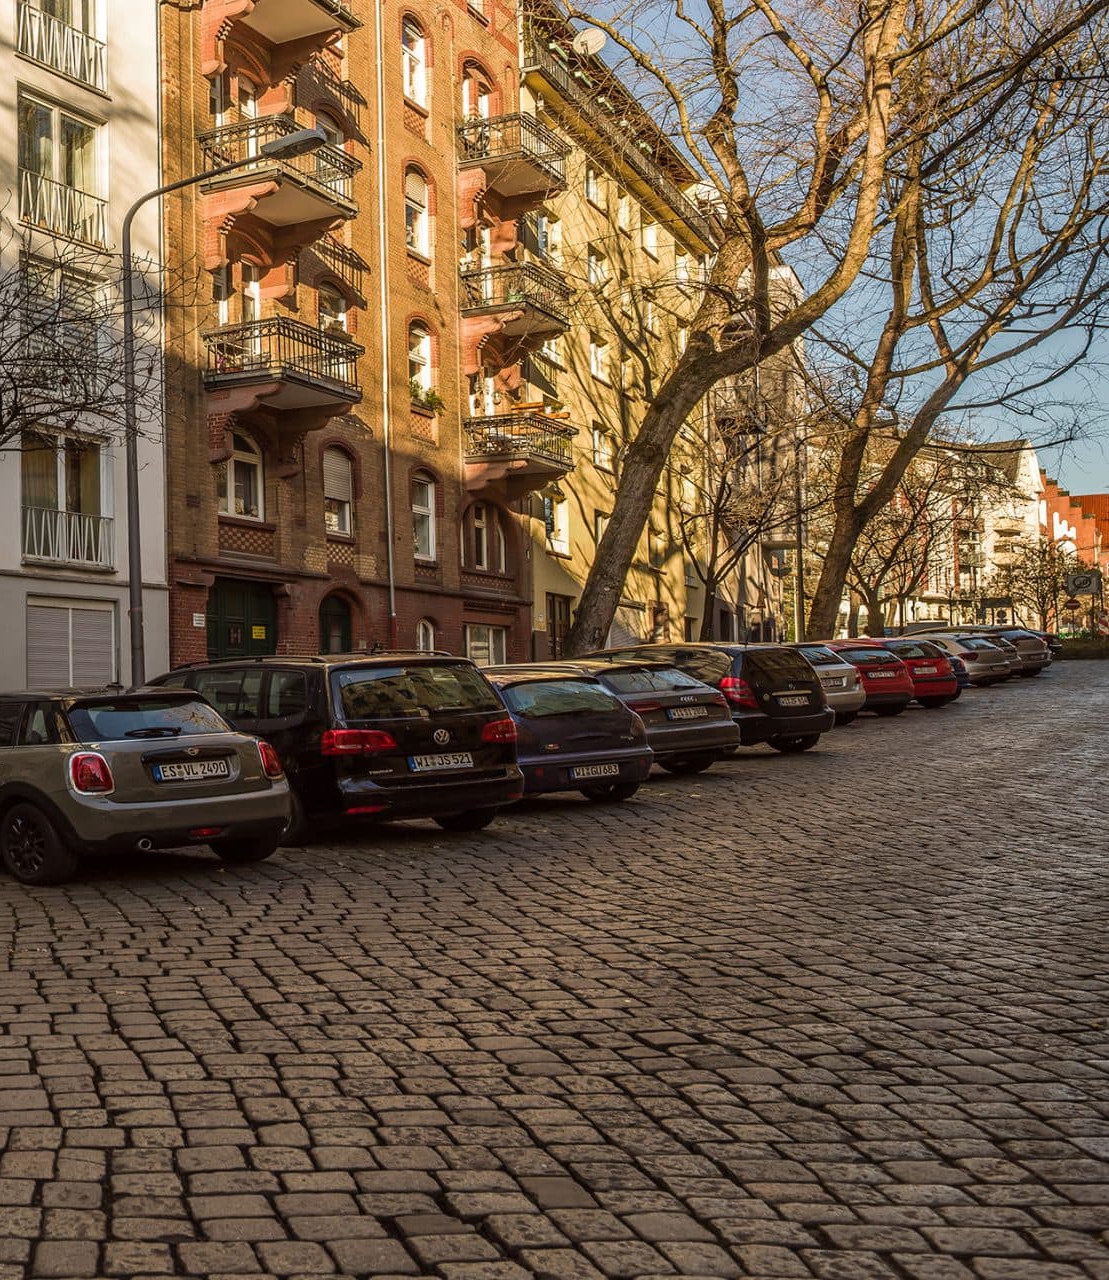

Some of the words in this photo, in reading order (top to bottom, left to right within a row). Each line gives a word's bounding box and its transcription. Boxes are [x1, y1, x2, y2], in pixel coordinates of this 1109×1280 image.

[415, 756, 430, 768] WI
[437, 755, 452, 766] JS
[451, 753, 472, 765] 521
[161, 765, 177, 778] ES
[183, 763, 199, 776] VL
[200, 761, 227, 775] 2490
